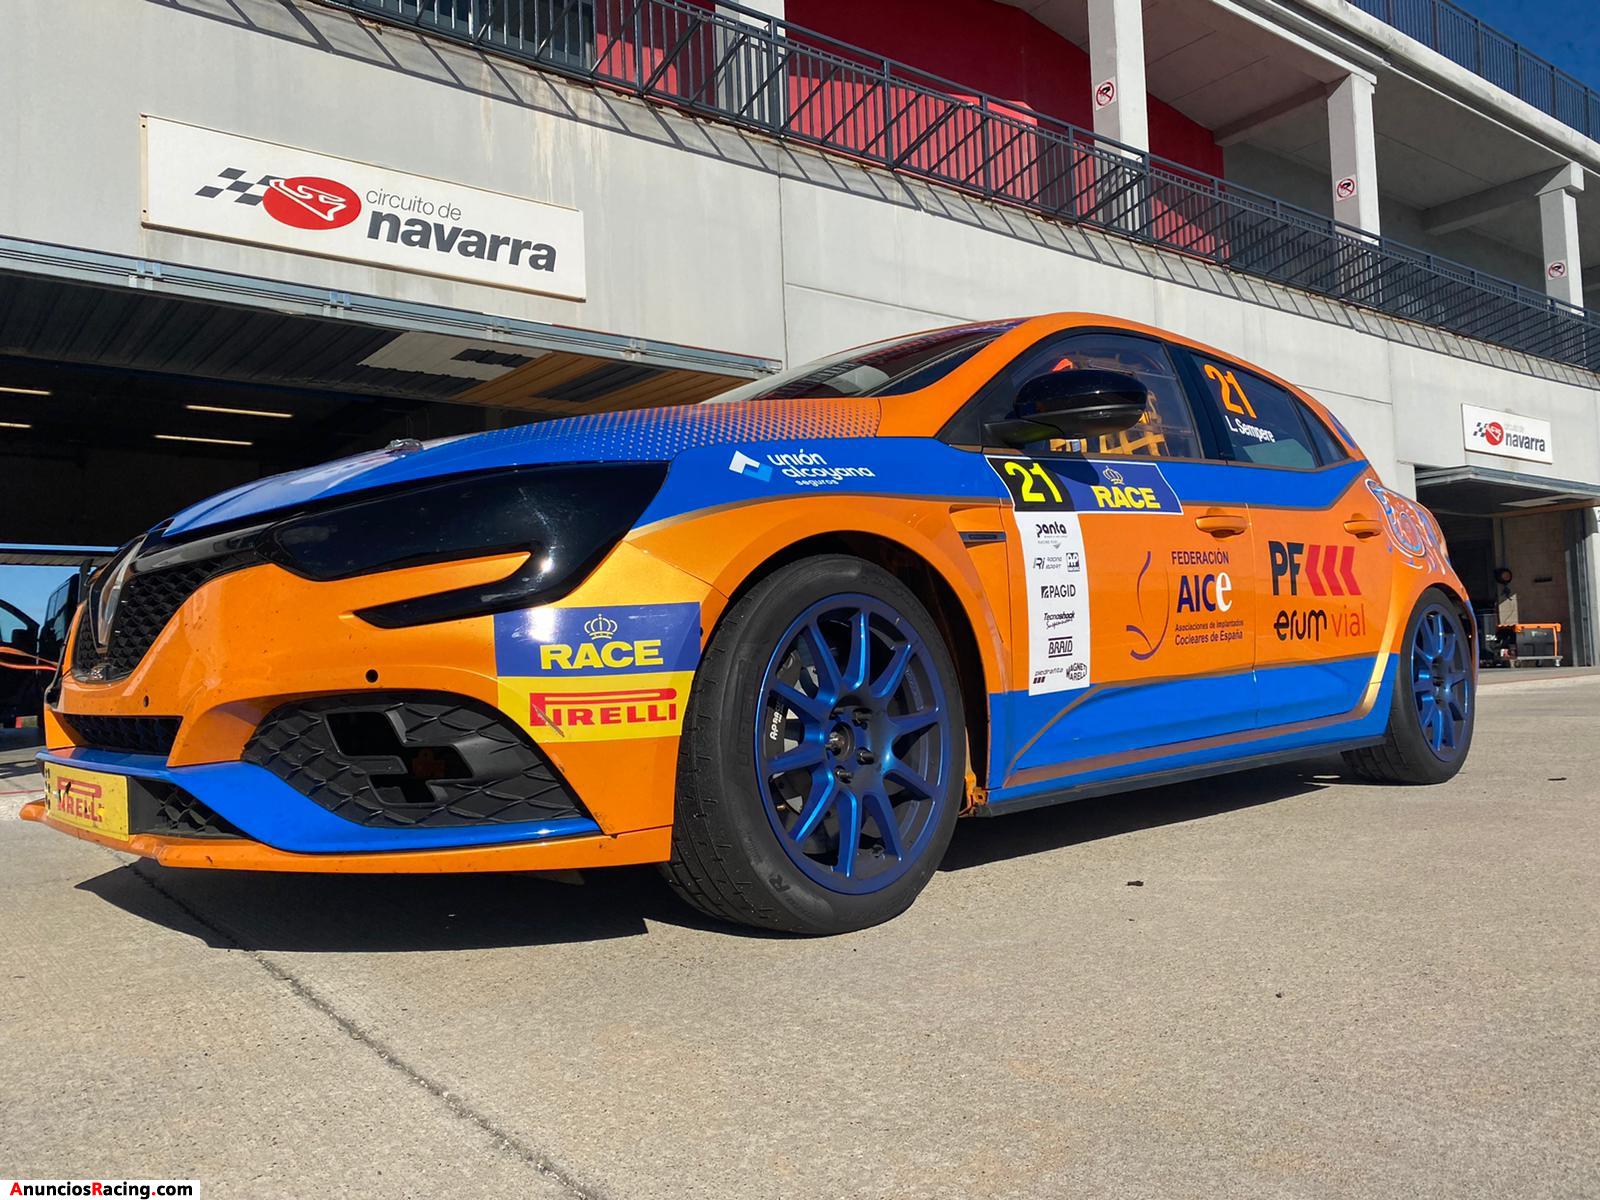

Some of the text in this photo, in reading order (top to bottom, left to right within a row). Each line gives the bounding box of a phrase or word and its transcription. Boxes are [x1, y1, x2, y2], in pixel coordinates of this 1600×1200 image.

[366, 188, 462, 221] circuito de
[366, 210, 557, 273] navarra
[1203, 363, 1258, 420] 21
[1504, 432, 1546, 453] navarra
[766, 448, 828, 466] unión
[781, 463, 876, 481] alcoyana
[1003, 461, 1063, 503] 21
[795, 479, 839, 487] seguros
[1090, 485, 1162, 509] RACE
[1035, 521, 1067, 538] panta
[1171, 547, 1230, 565] FEDERACIÓN
[1267, 540, 1305, 597] PF
[1049, 584, 1077, 598] PAGID
[1174, 622, 1208, 632] Asociaciones
[1209, 621, 1216, 629] de
[1273, 603, 1366, 642] erum vial
[1048, 640, 1073, 655] BRAID
[1174, 628, 1243, 646] Cocleares de España
[539, 639, 664, 670] RACE
[529, 688, 677, 728] PIRELLI
